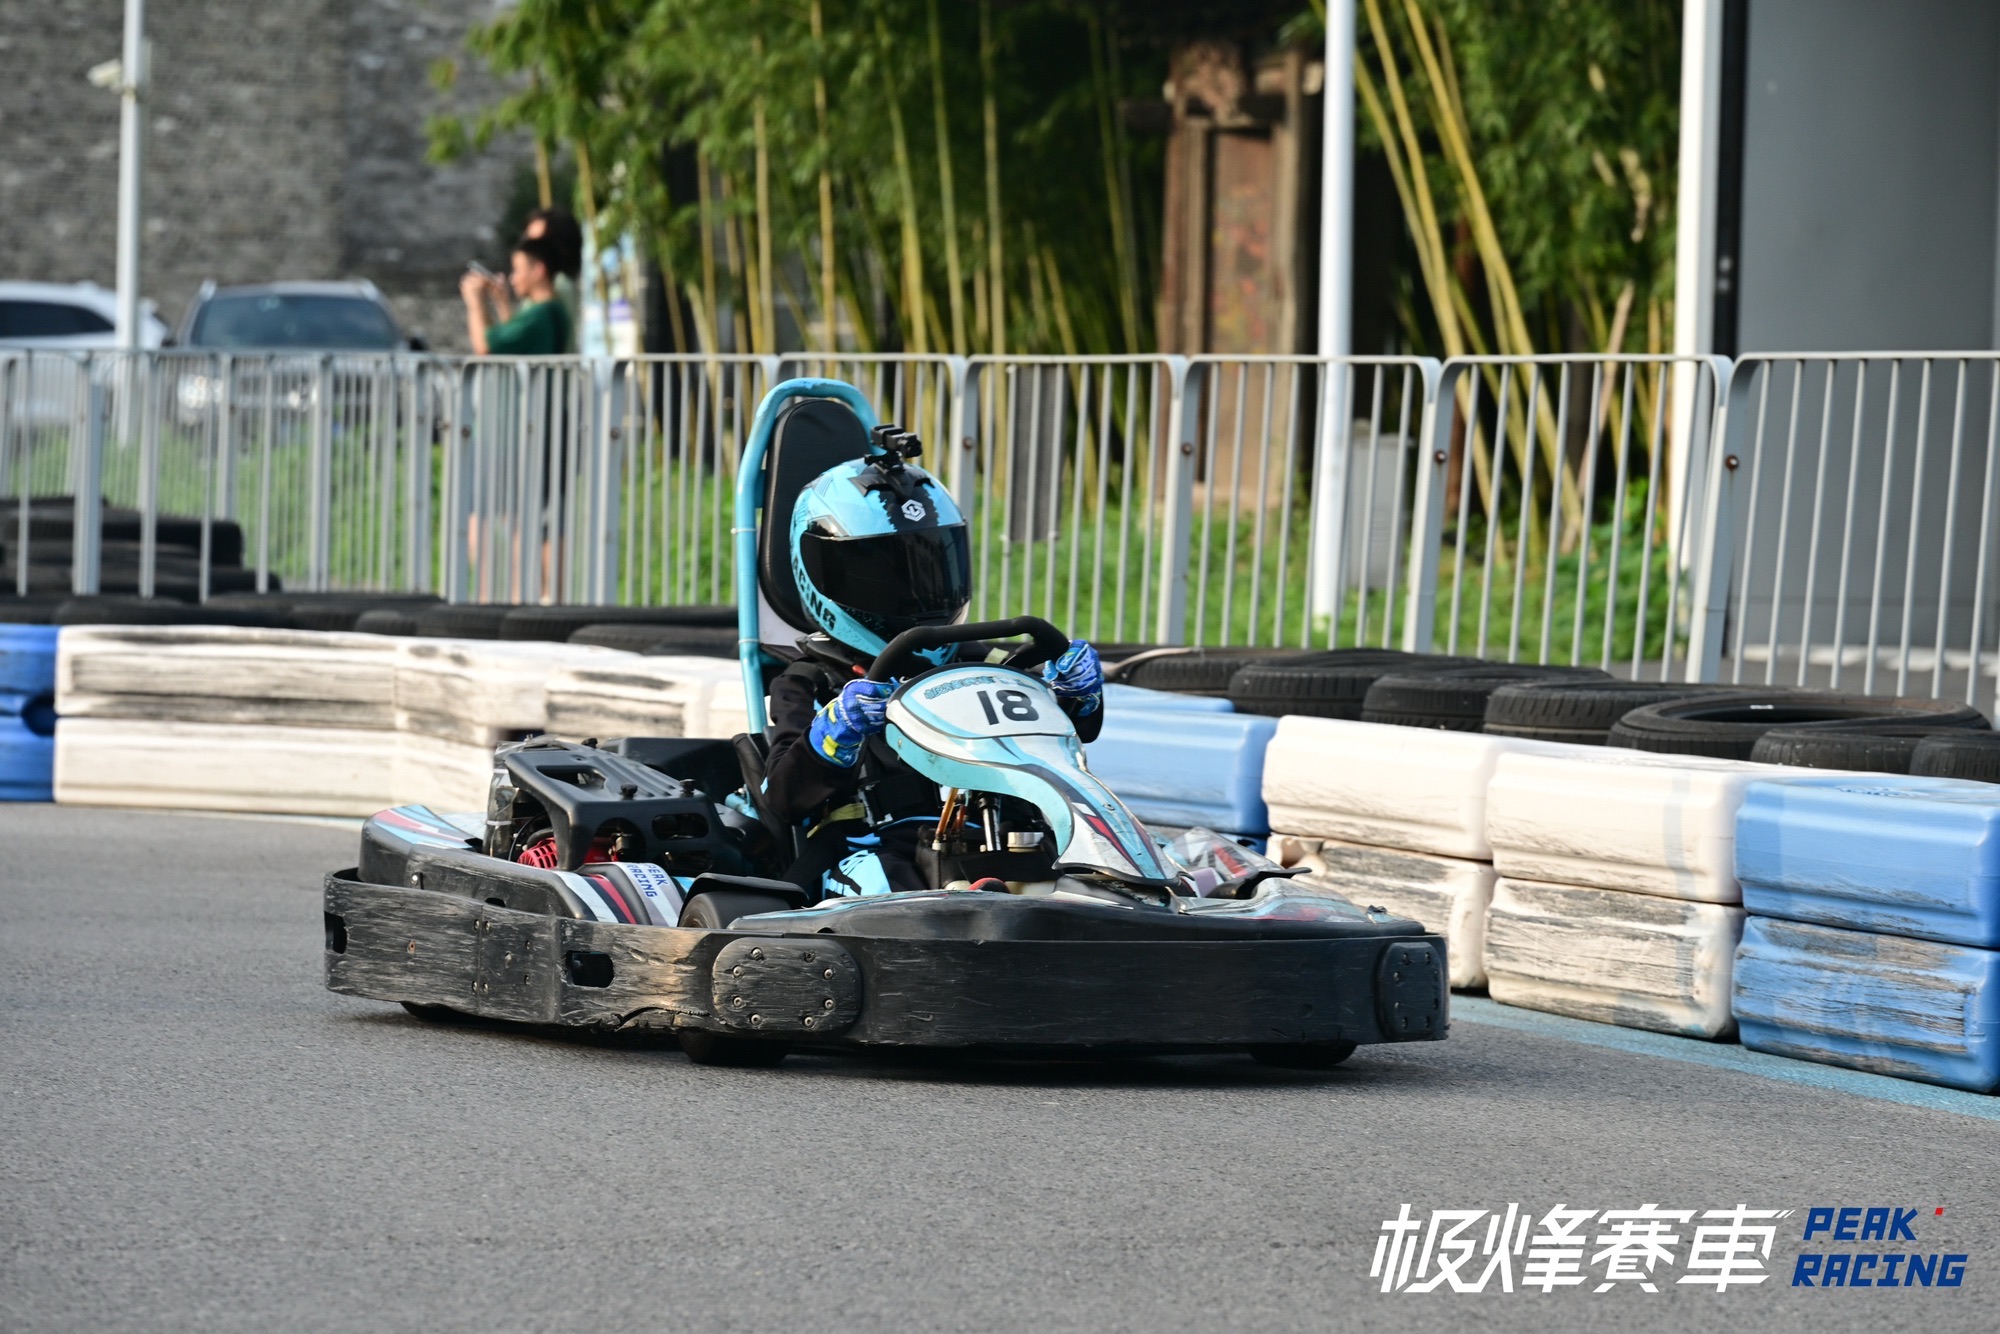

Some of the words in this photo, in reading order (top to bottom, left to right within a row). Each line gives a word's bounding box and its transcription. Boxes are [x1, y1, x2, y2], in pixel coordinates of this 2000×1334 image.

[976, 689, 1040, 726] 18
[627, 864, 658, 898] RACING
[645, 864, 669, 886] PEAK
